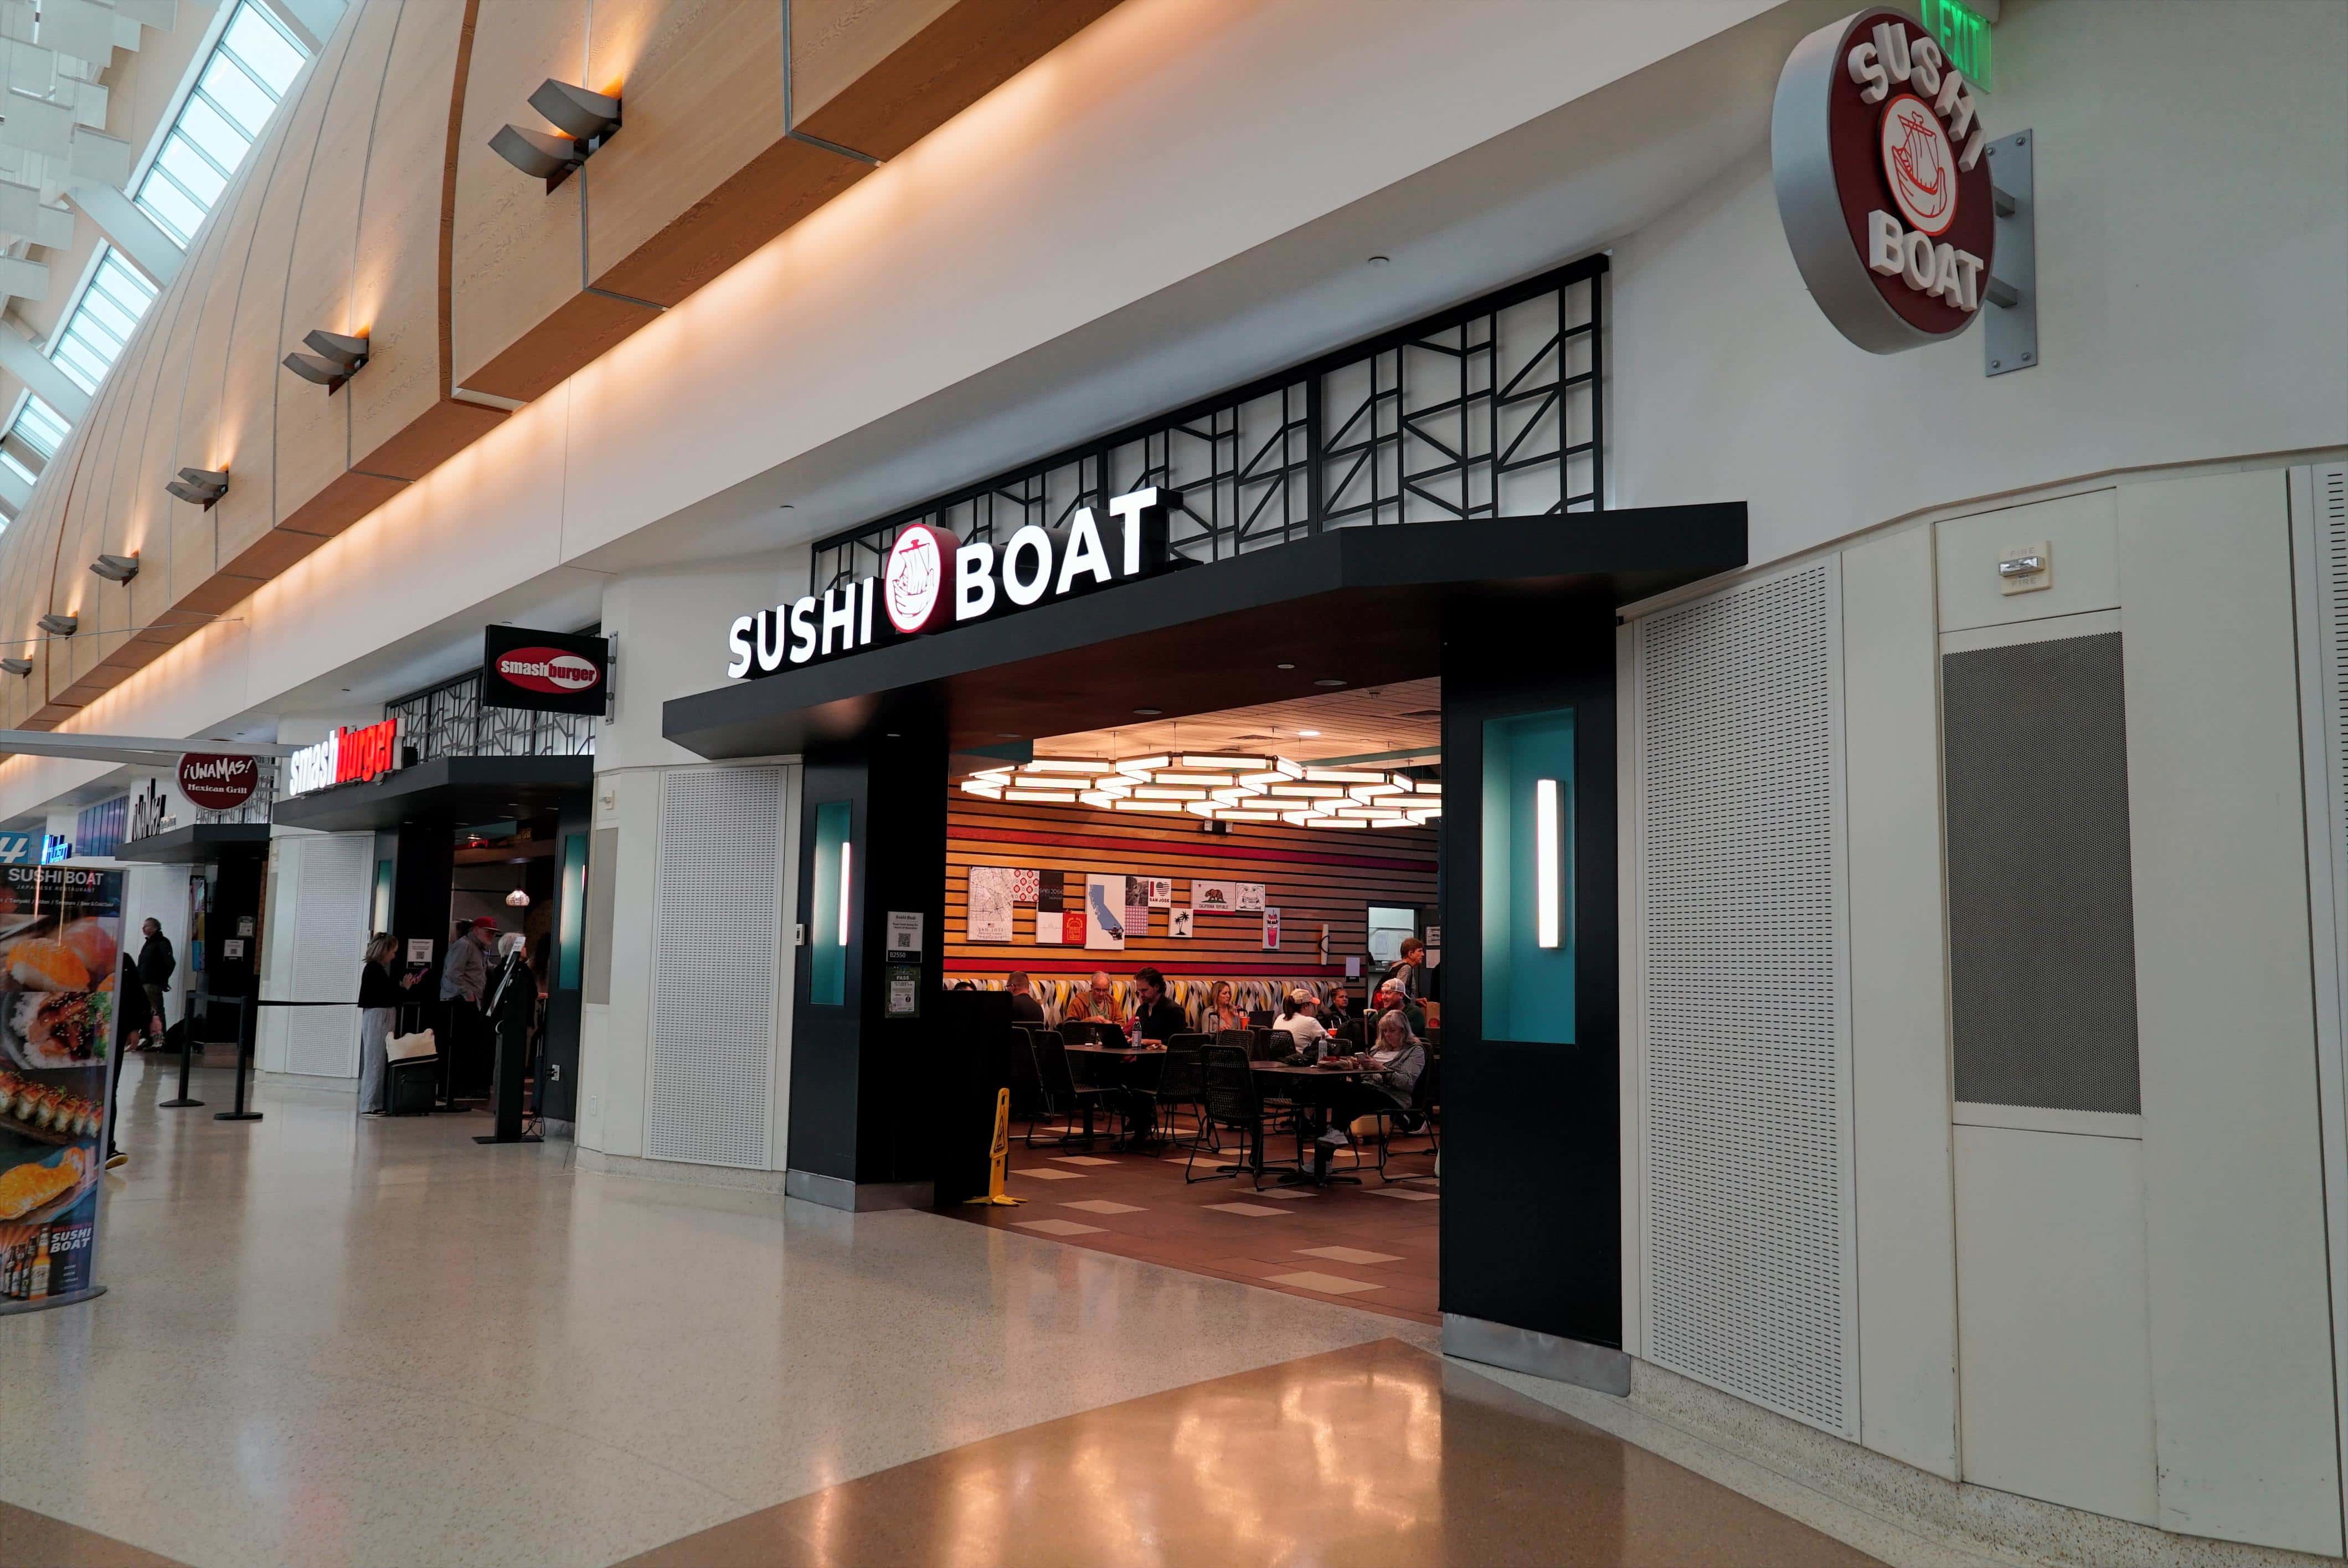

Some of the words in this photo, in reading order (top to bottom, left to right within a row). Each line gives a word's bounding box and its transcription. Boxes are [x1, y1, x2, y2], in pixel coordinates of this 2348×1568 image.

[1939, 0, 1979, 80] EXIT
[1848, 22, 1986, 173] SUSHI
[1868, 209, 1984, 312] BOAT
[2011, 547, 2034, 557] FIRE
[727, 576, 874, 679] SUSHI
[955, 486, 1159, 621] BOAT
[2011, 577, 2037, 586] FIRE
[501, 660, 595, 682] smashburger
[290, 718, 397, 796] smashburger
[188, 783, 224, 793] Mexican
[226, 786, 248, 794] Grill
[8, 868, 61, 884] SUSHI
[65, 871, 104, 885] BOAT
[50, 1227, 92, 1244] SUSHI
[50, 1236, 91, 1254] BOAT
